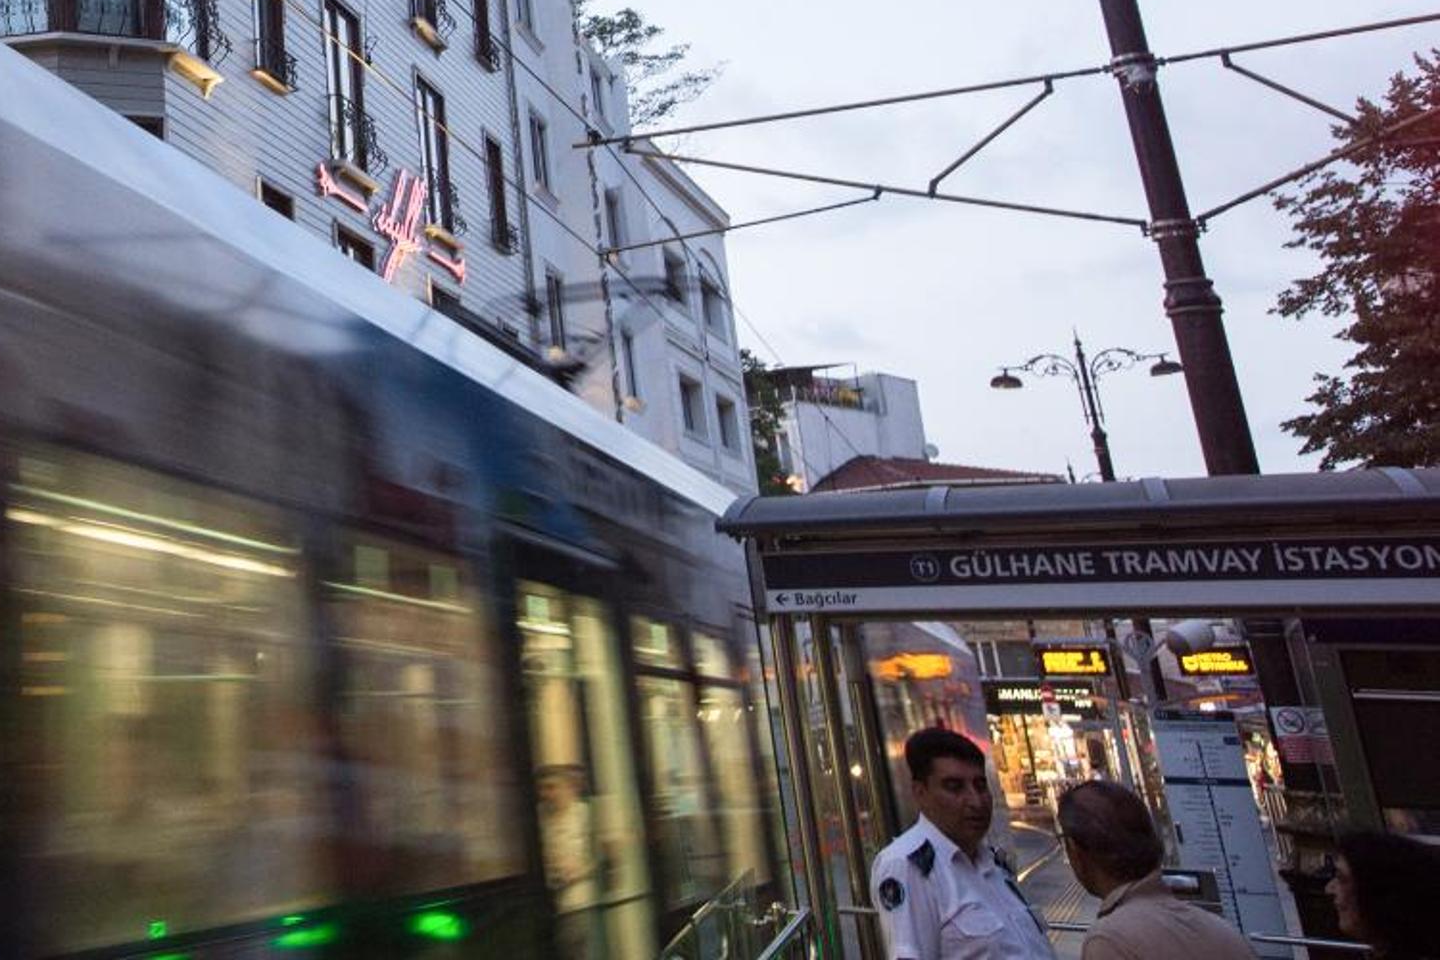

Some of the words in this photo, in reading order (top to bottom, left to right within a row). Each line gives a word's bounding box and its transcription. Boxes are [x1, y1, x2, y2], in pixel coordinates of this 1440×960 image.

[915, 561, 935, 575] T1
[950, 551, 1096, 577] GÜLHANE
[1101, 547, 1262, 574] TRAMVAY
[794, 591, 857, 608] Bağcılar
